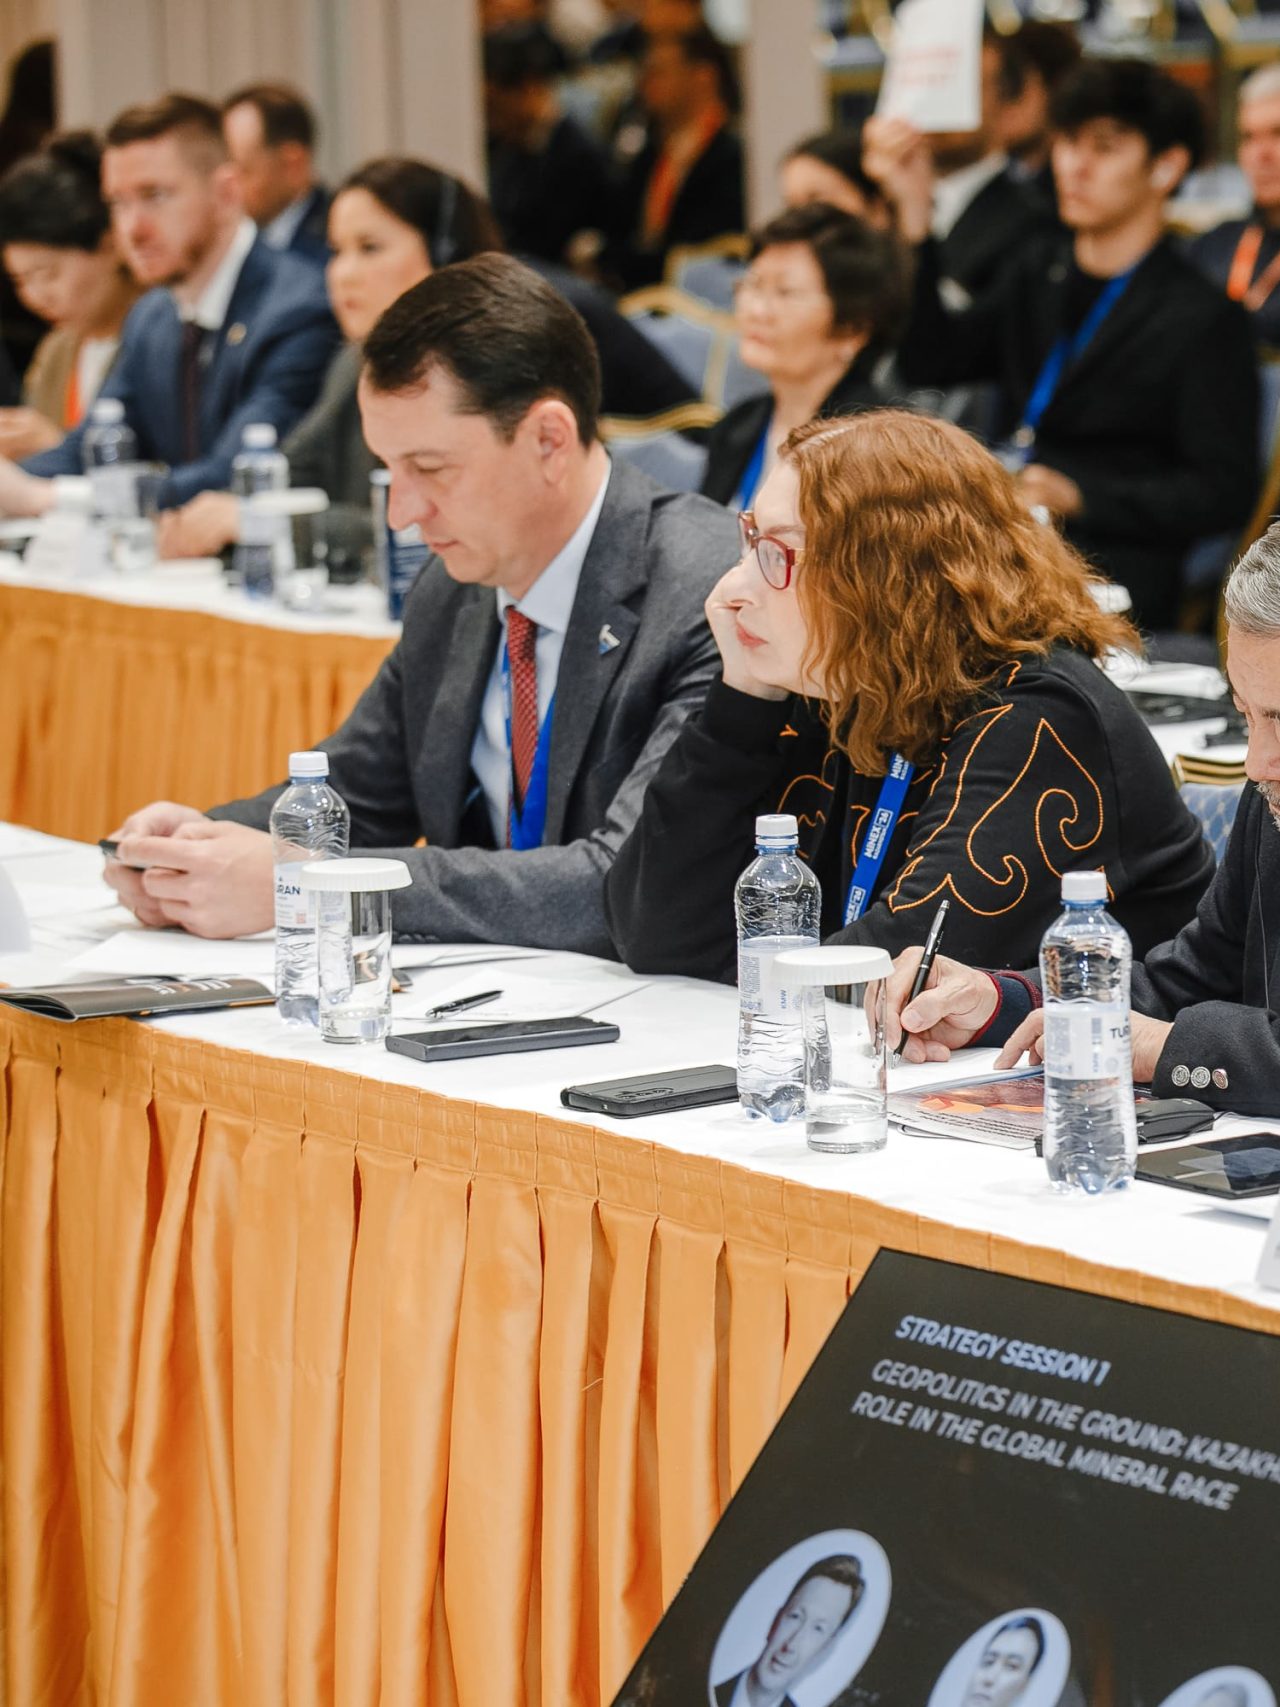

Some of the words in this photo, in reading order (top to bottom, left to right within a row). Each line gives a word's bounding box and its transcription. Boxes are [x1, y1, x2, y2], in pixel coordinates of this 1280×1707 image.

[864, 825, 882, 858] MINEX
[276, 884, 301, 895] RAN
[895, 1315, 1006, 1360] STRATEGY
[1000, 1340, 1098, 1385] SESSION
[1093, 1361, 1112, 1387] 1
[871, 1359, 1011, 1412] GEOPOLITICS
[1007, 1391, 1038, 1419] IN
[1035, 1398, 1084, 1431] THE
[1080, 1410, 1188, 1457] GROUND:
[851, 1391, 913, 1426] ROLE
[908, 1407, 938, 1433] IN
[936, 1411, 984, 1445] THE
[980, 1425, 1067, 1468] GLOBAL
[1067, 1445, 1170, 1495] MINERAL
[1168, 1471, 1240, 1510] RACE
